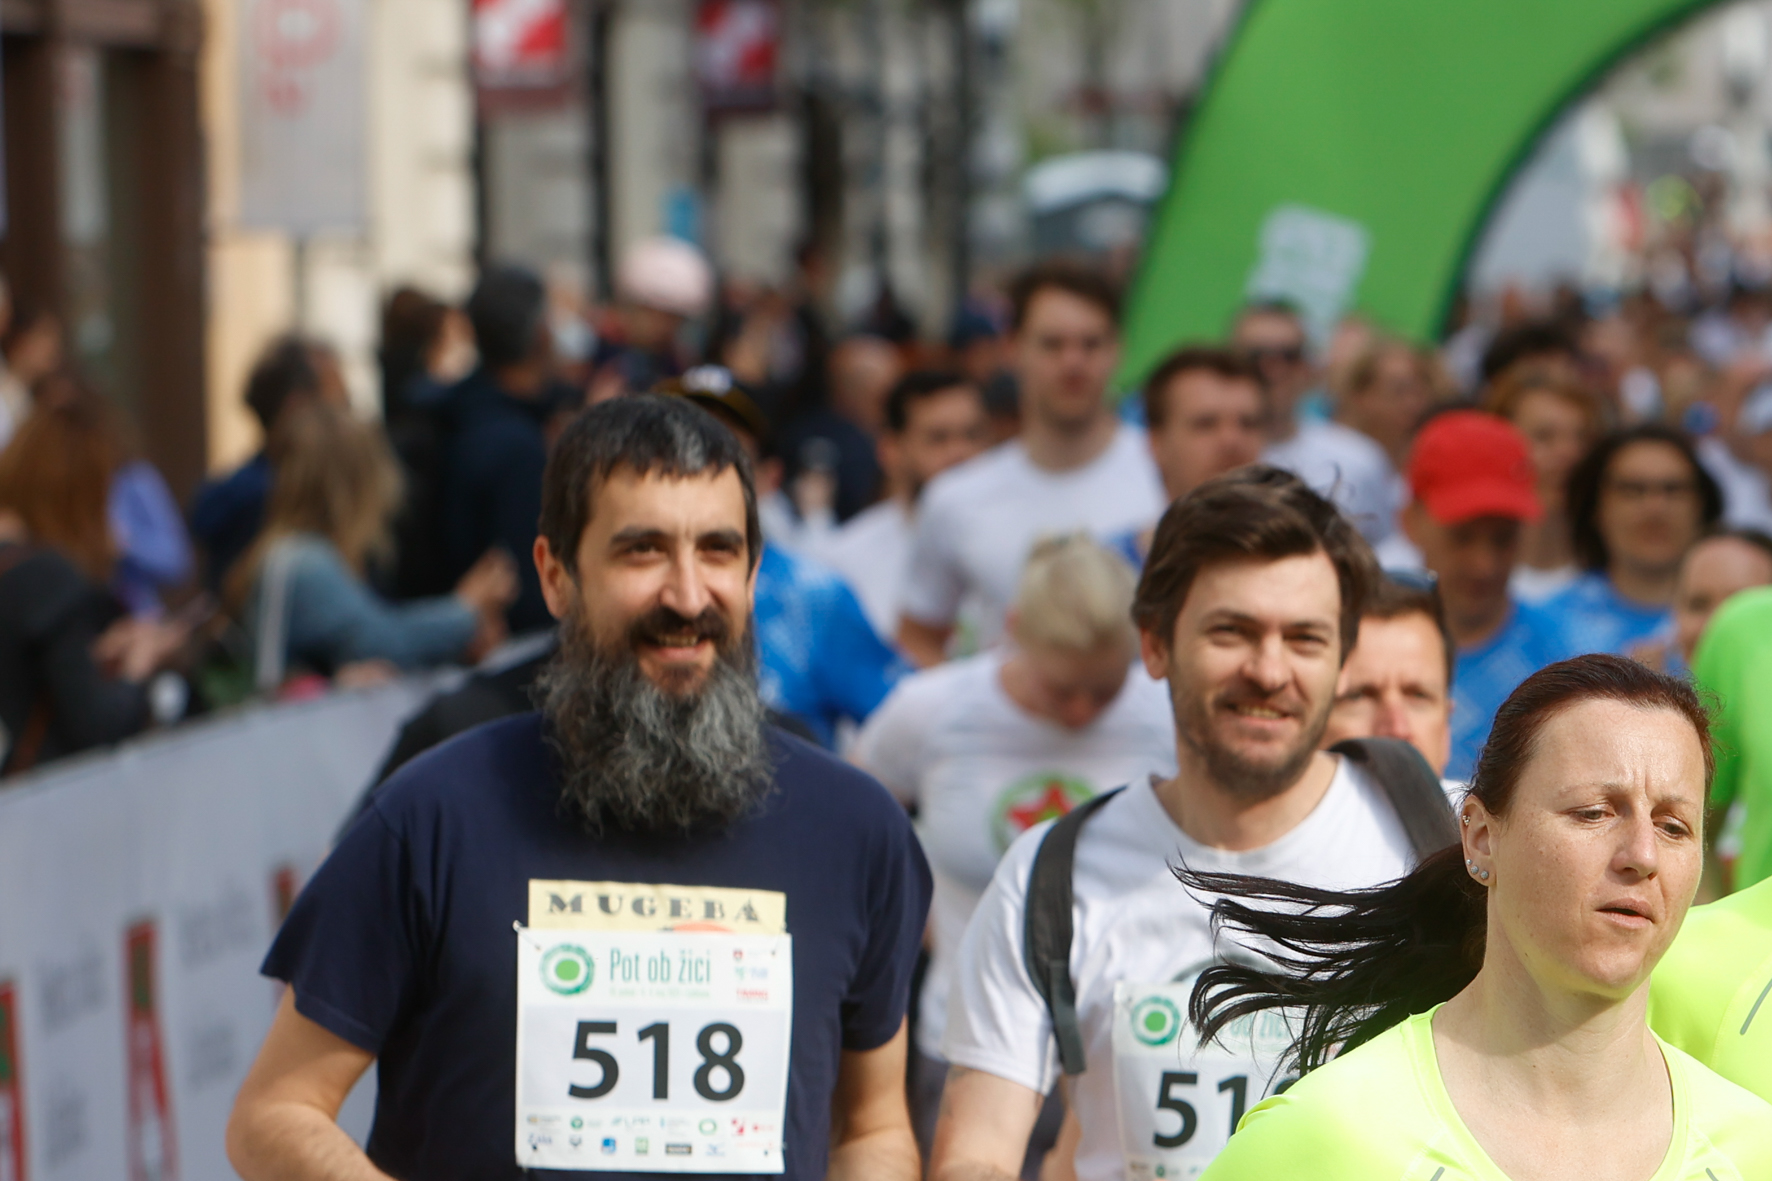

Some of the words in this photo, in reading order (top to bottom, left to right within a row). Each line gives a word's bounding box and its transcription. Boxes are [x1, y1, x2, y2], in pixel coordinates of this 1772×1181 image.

[610, 948, 640, 982] Pot
[648, 951, 671, 982] ob
[678, 950, 711, 983] žici
[568, 1020, 745, 1102] 518
[1153, 1071, 1300, 1148] 51
